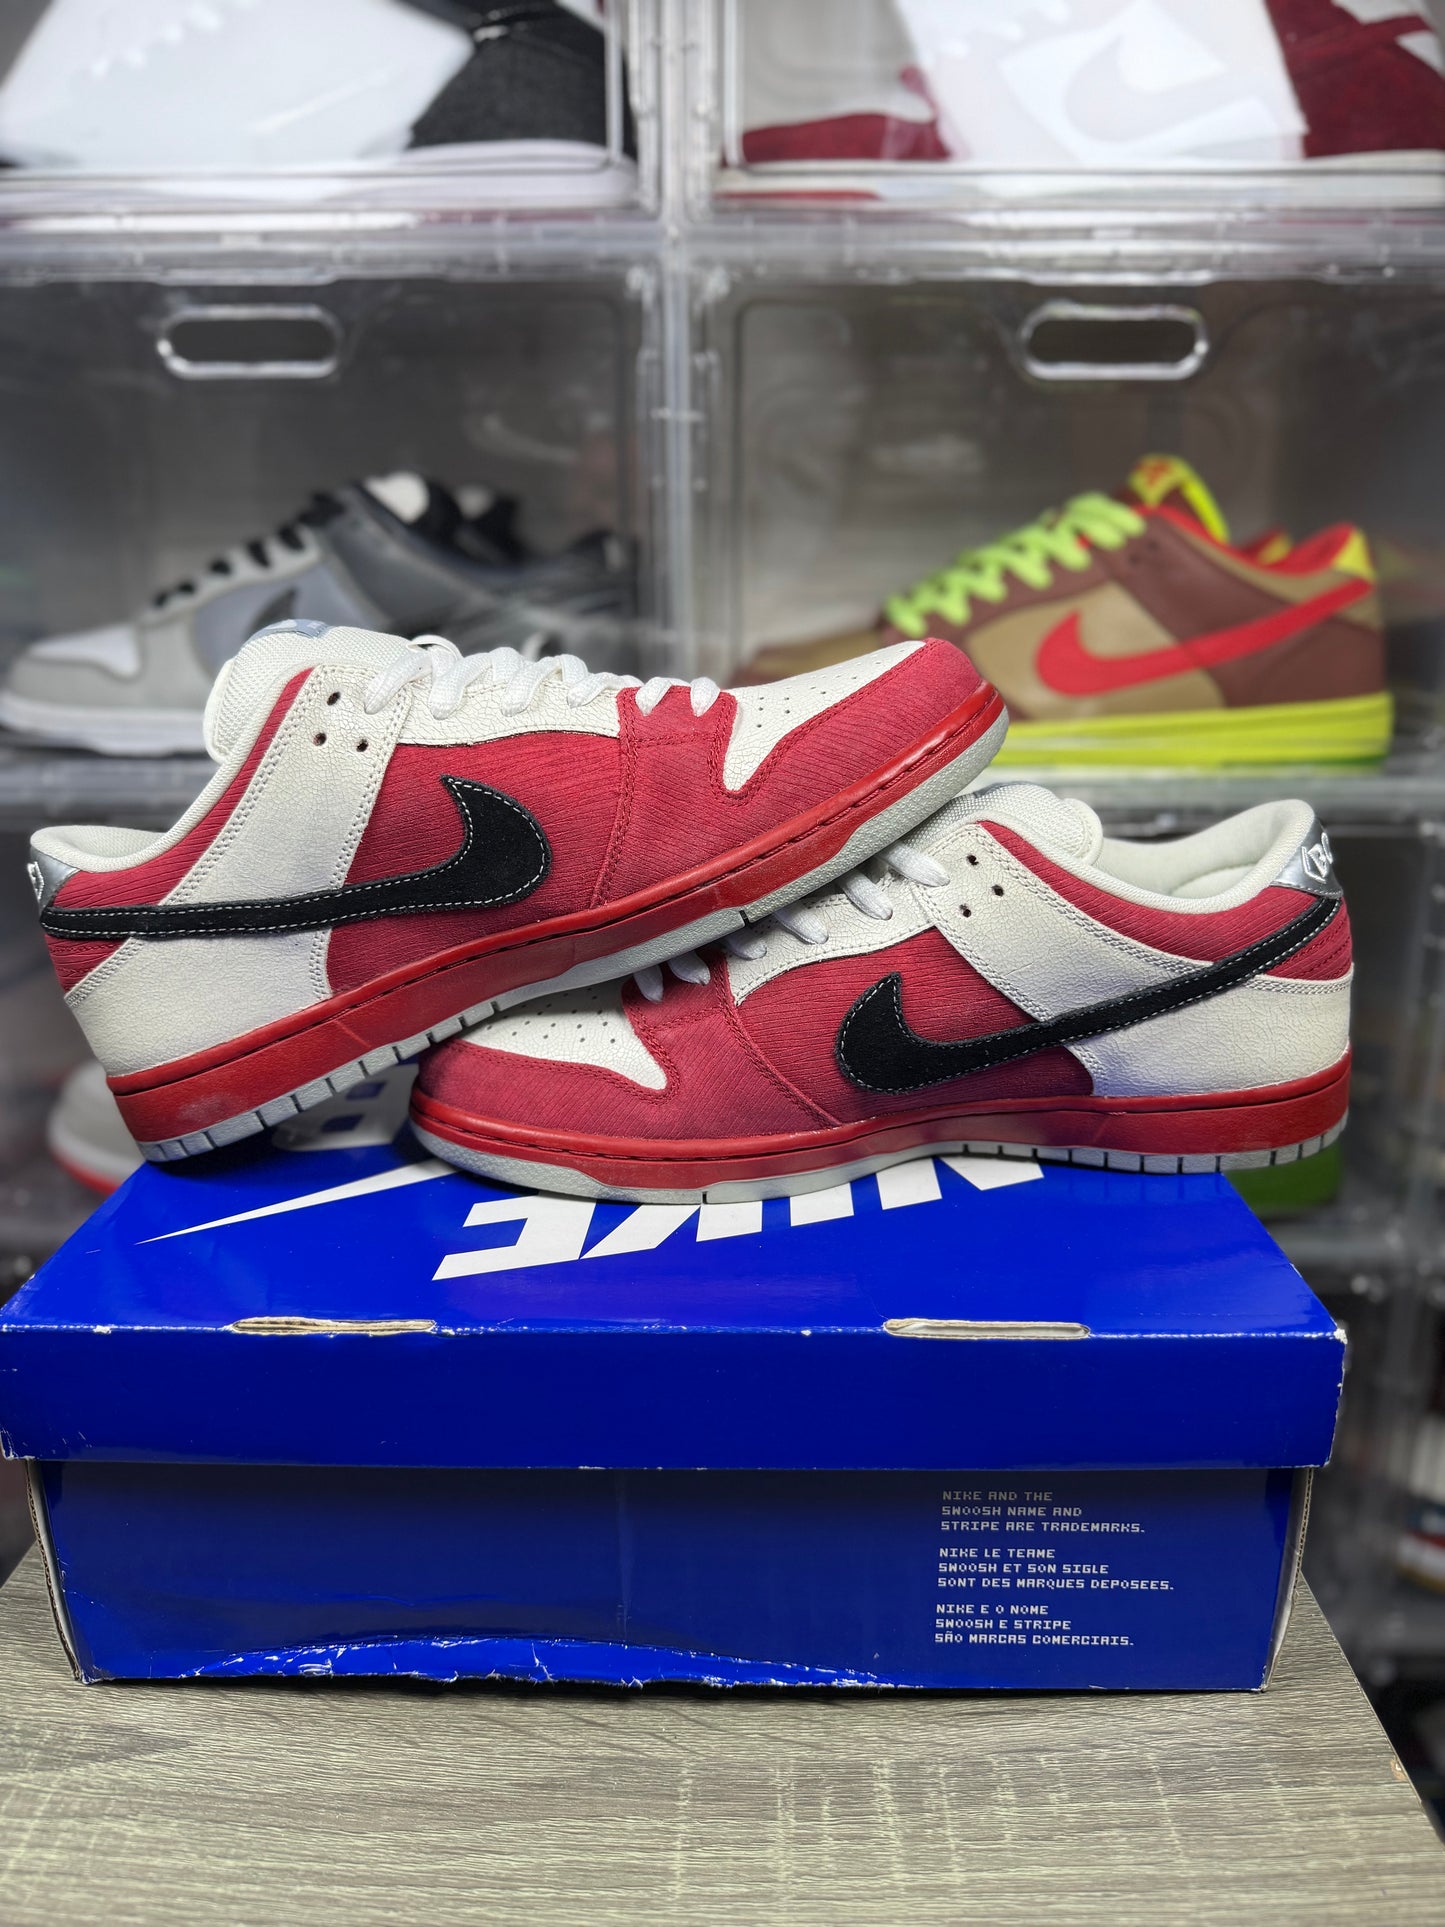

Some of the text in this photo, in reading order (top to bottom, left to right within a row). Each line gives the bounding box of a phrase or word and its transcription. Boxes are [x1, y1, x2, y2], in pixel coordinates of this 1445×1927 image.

[942, 1490, 1053, 1501] NIKE AND THE
[941, 1505, 1083, 1517] SWOOSH NAME AND
[940, 1520, 1145, 1533] STRIPE ARE TRADEMARKS.
[939, 1547, 979, 1558] NIKE
[983, 1548, 1002, 1558] LE
[938, 1562, 1110, 1575] SWOOSH ET SON SIGLE
[937, 1577, 1175, 1591] SONT DES MARQUES DEPOSEES.
[935, 1603, 1049, 1616] NIKE E O NOME
[935, 1618, 1072, 1631] SWOOSH E STRIPE
[934, 1630, 1135, 1646] SÃO MARCAS COMERCIAIS.
